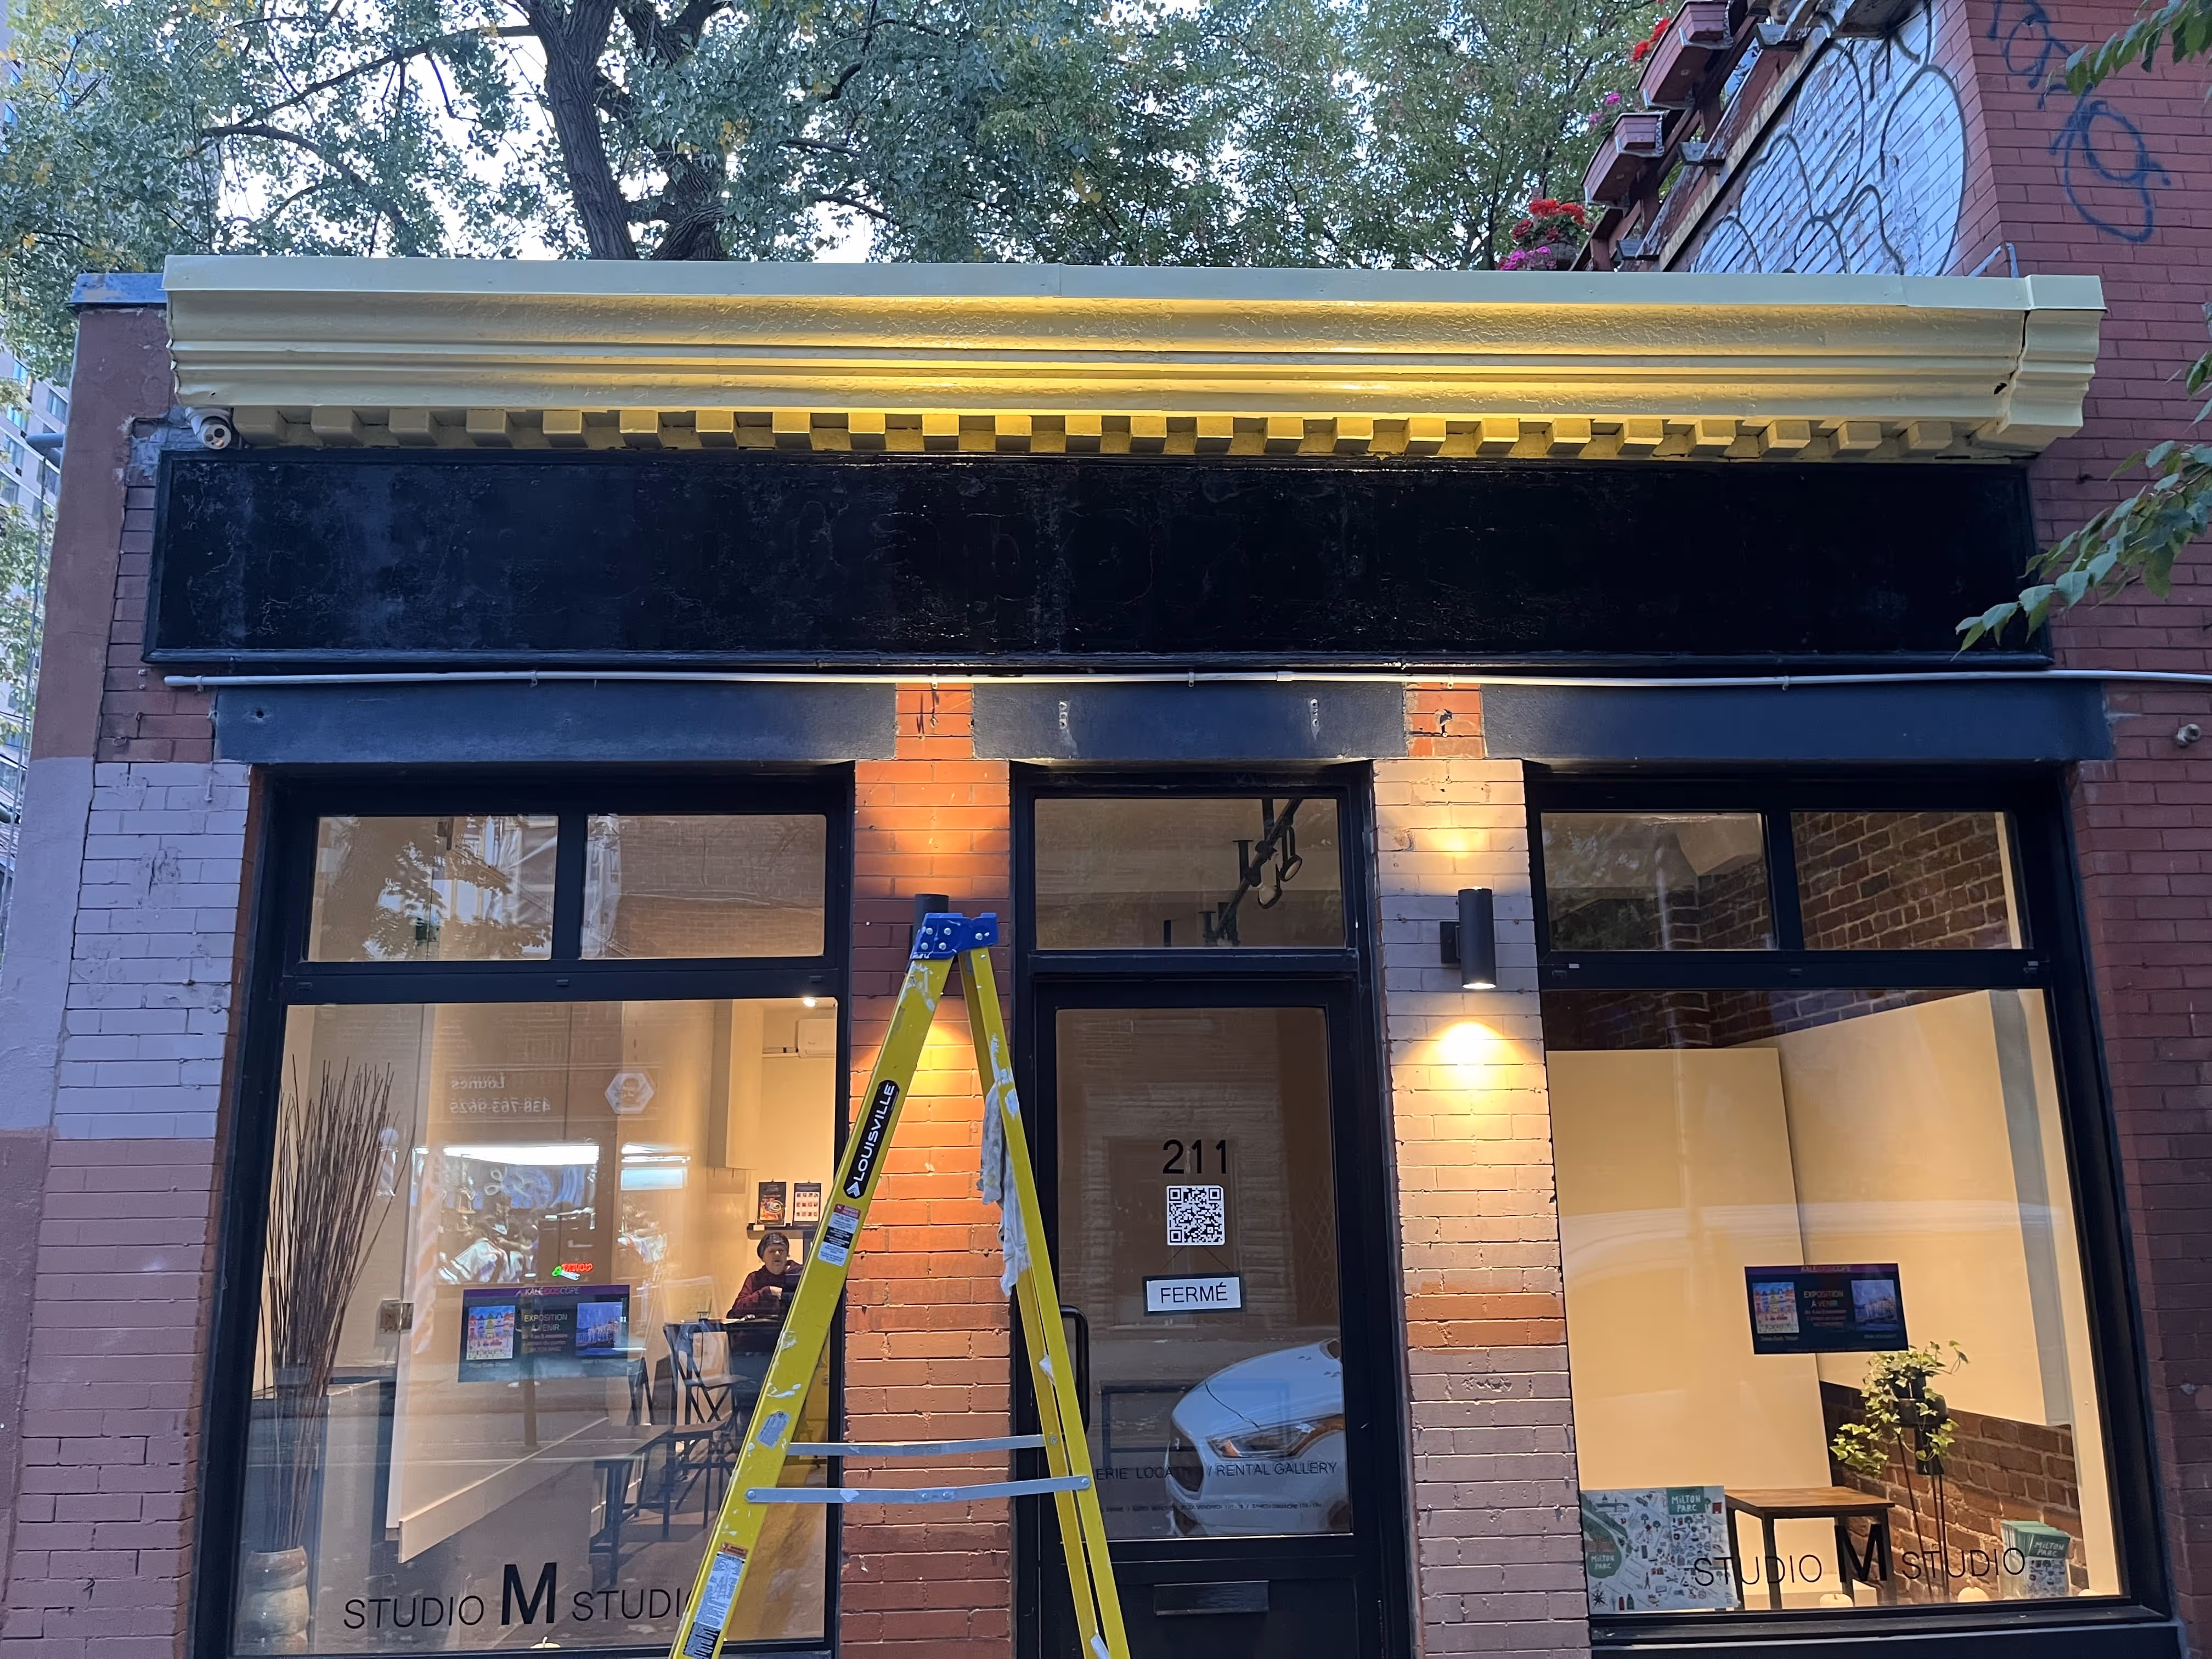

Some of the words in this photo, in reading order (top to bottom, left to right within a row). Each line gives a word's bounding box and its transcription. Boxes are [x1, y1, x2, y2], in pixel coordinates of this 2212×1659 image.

[853, 1084, 895, 1182] LOUISVILLE
[1163, 1139, 1227, 1174] 211
[1160, 1282, 1228, 1304] FERMÉ
[524, 1313, 568, 1322] EXPOSITION
[1096, 1467, 1128, 1480] ERIE
[1137, 1466, 1173, 1479] LOCA
[1217, 1464, 1271, 1477] RENTAL
[1274, 1462, 1337, 1475] GALLERY
[1677, 1504, 1697, 1513] PARC
[1694, 1554, 1822, 1587] STUDIO
[1835, 1523, 1888, 1583] M
[1901, 1547, 2025, 1579] STUDIO
[343, 1595, 484, 1629] STUDIO
[501, 1562, 557, 1626] M
[572, 1587, 691, 1621] STUDI
